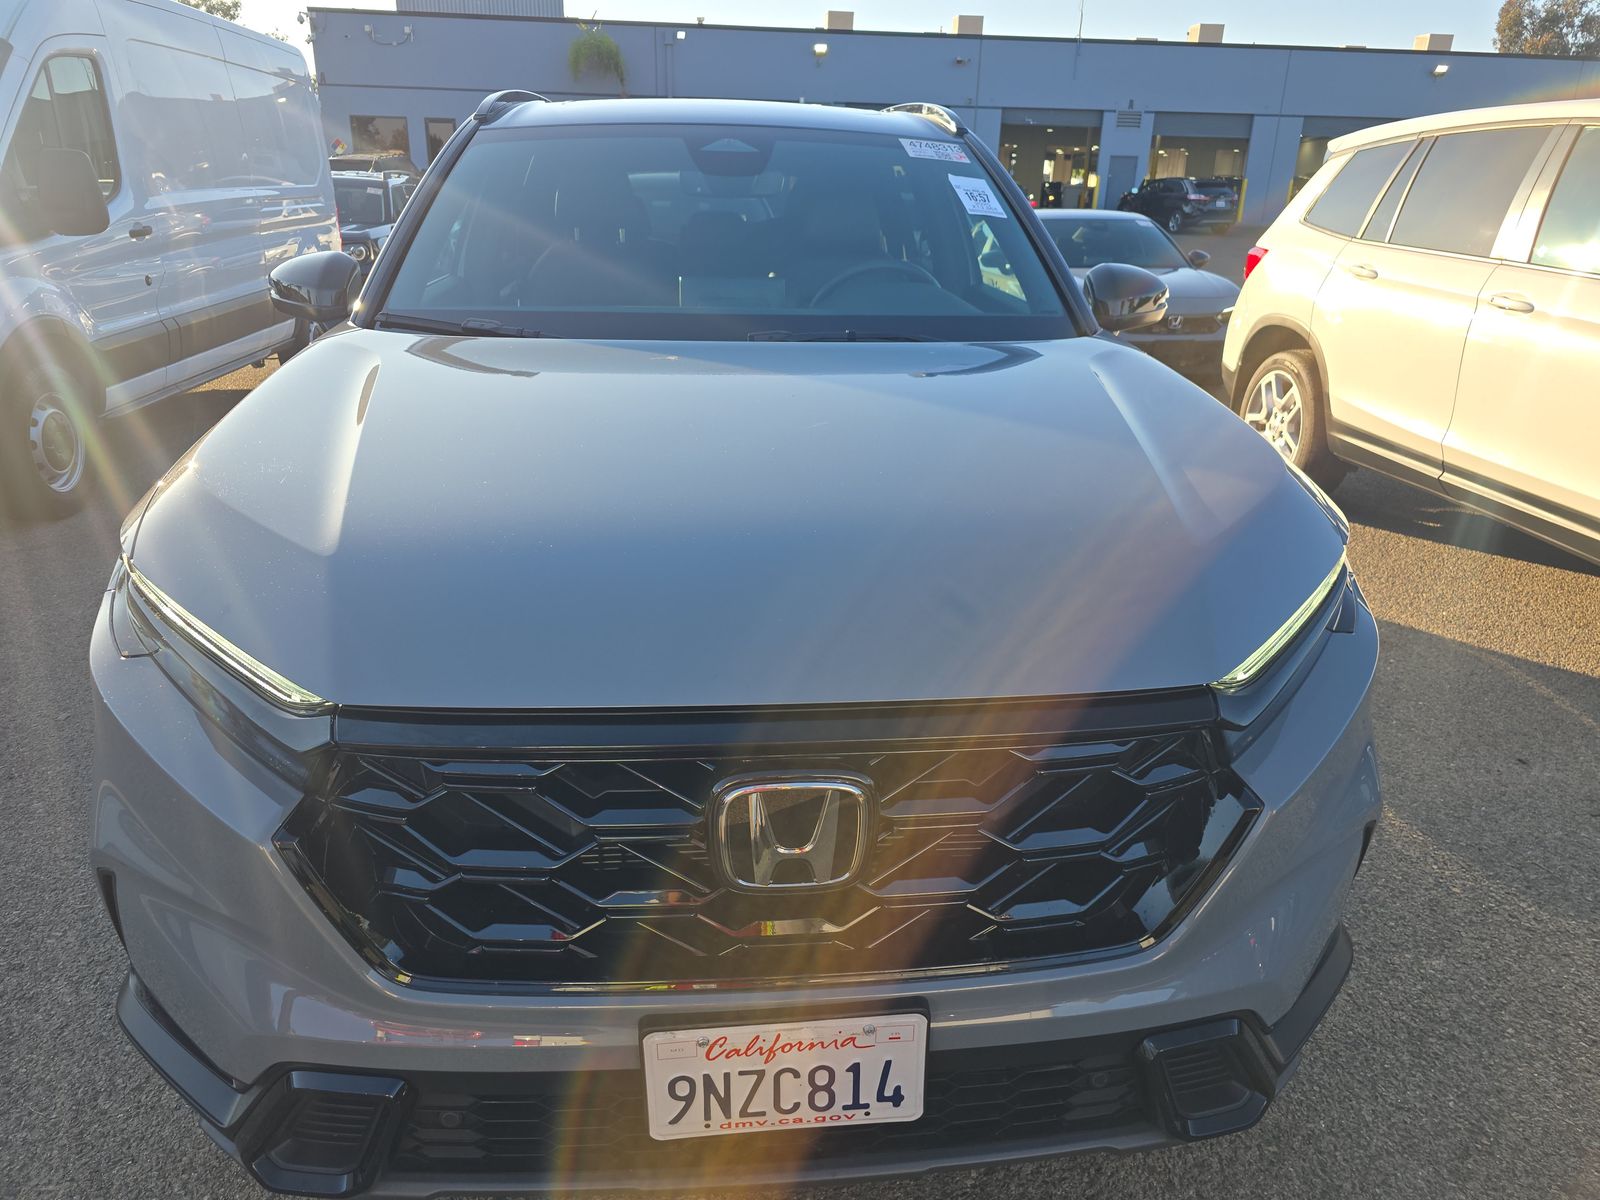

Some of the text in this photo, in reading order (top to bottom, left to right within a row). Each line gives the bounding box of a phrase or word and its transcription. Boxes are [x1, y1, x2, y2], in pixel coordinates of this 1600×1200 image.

[965, 191, 991, 204] 16:57
[705, 1030, 876, 1064] California
[667, 1059, 905, 1126] 9NZC814
[719, 1113, 857, 1130] dmv.ca.gov
